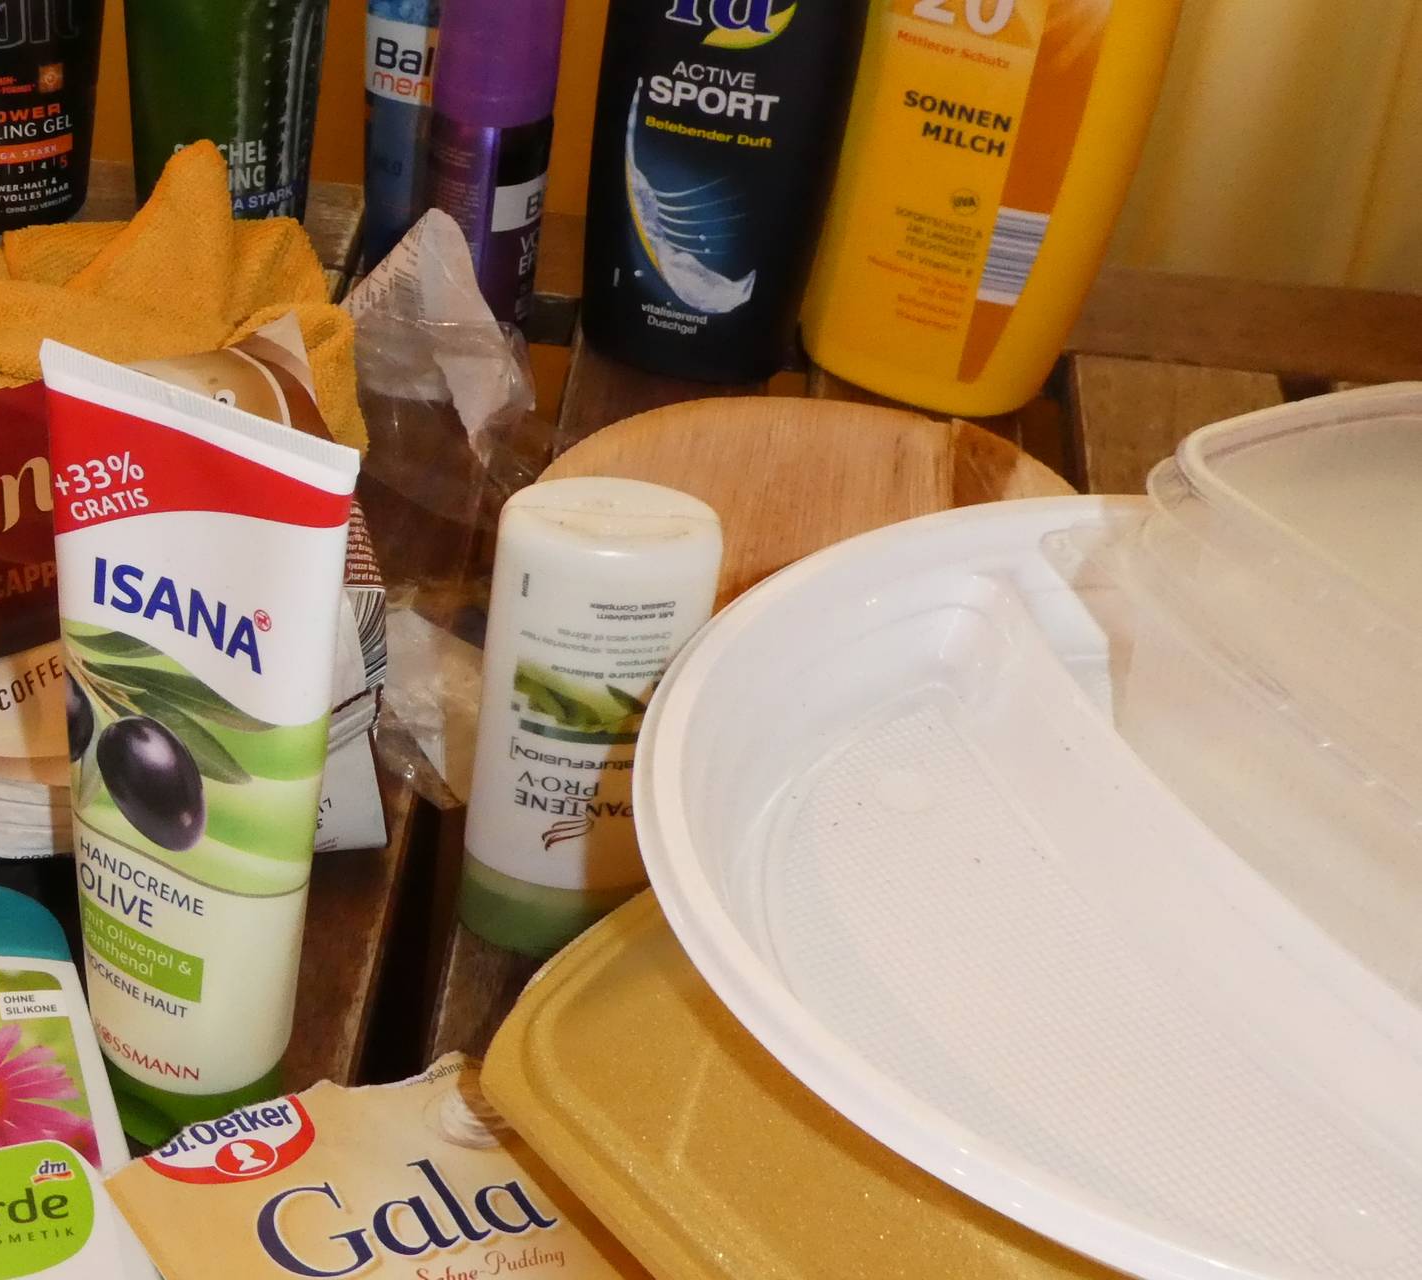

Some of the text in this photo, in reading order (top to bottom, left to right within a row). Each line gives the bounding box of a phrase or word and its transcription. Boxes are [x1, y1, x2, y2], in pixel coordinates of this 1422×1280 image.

[672, 60, 757, 90] ACTIVE
[648, 75, 780, 122] SPORT
[903, 90, 1013, 133] SONNEN
[43, 114, 73, 134] GEL
[645, 115, 773, 149] Belebender Duft
[921, 121, 1006, 158] MILCH
[248, 186, 293, 209] STARK
[647, 315, 698, 335] Duschgel
[55, 451, 145, 497] +33%
[70, 487, 150, 522] GRATIS
[92, 556, 262, 675] ISANA
[551, 664, 604, 681] Balance
[517, 770, 600, 798] PRO-V
[79, 836, 205, 917] HANDCREME
[80, 863, 154, 928] OLIVE
[107, 924, 174, 969] Olivenöl
[178, 960, 192, 977] &
[3, 993, 36, 1004] OHNE
[5, 1004, 58, 1015] SILIKONE
[143, 992, 188, 1019] HAUT
[38, 1159, 68, 1176] dm
[256, 1158, 558, 1277] Gala
